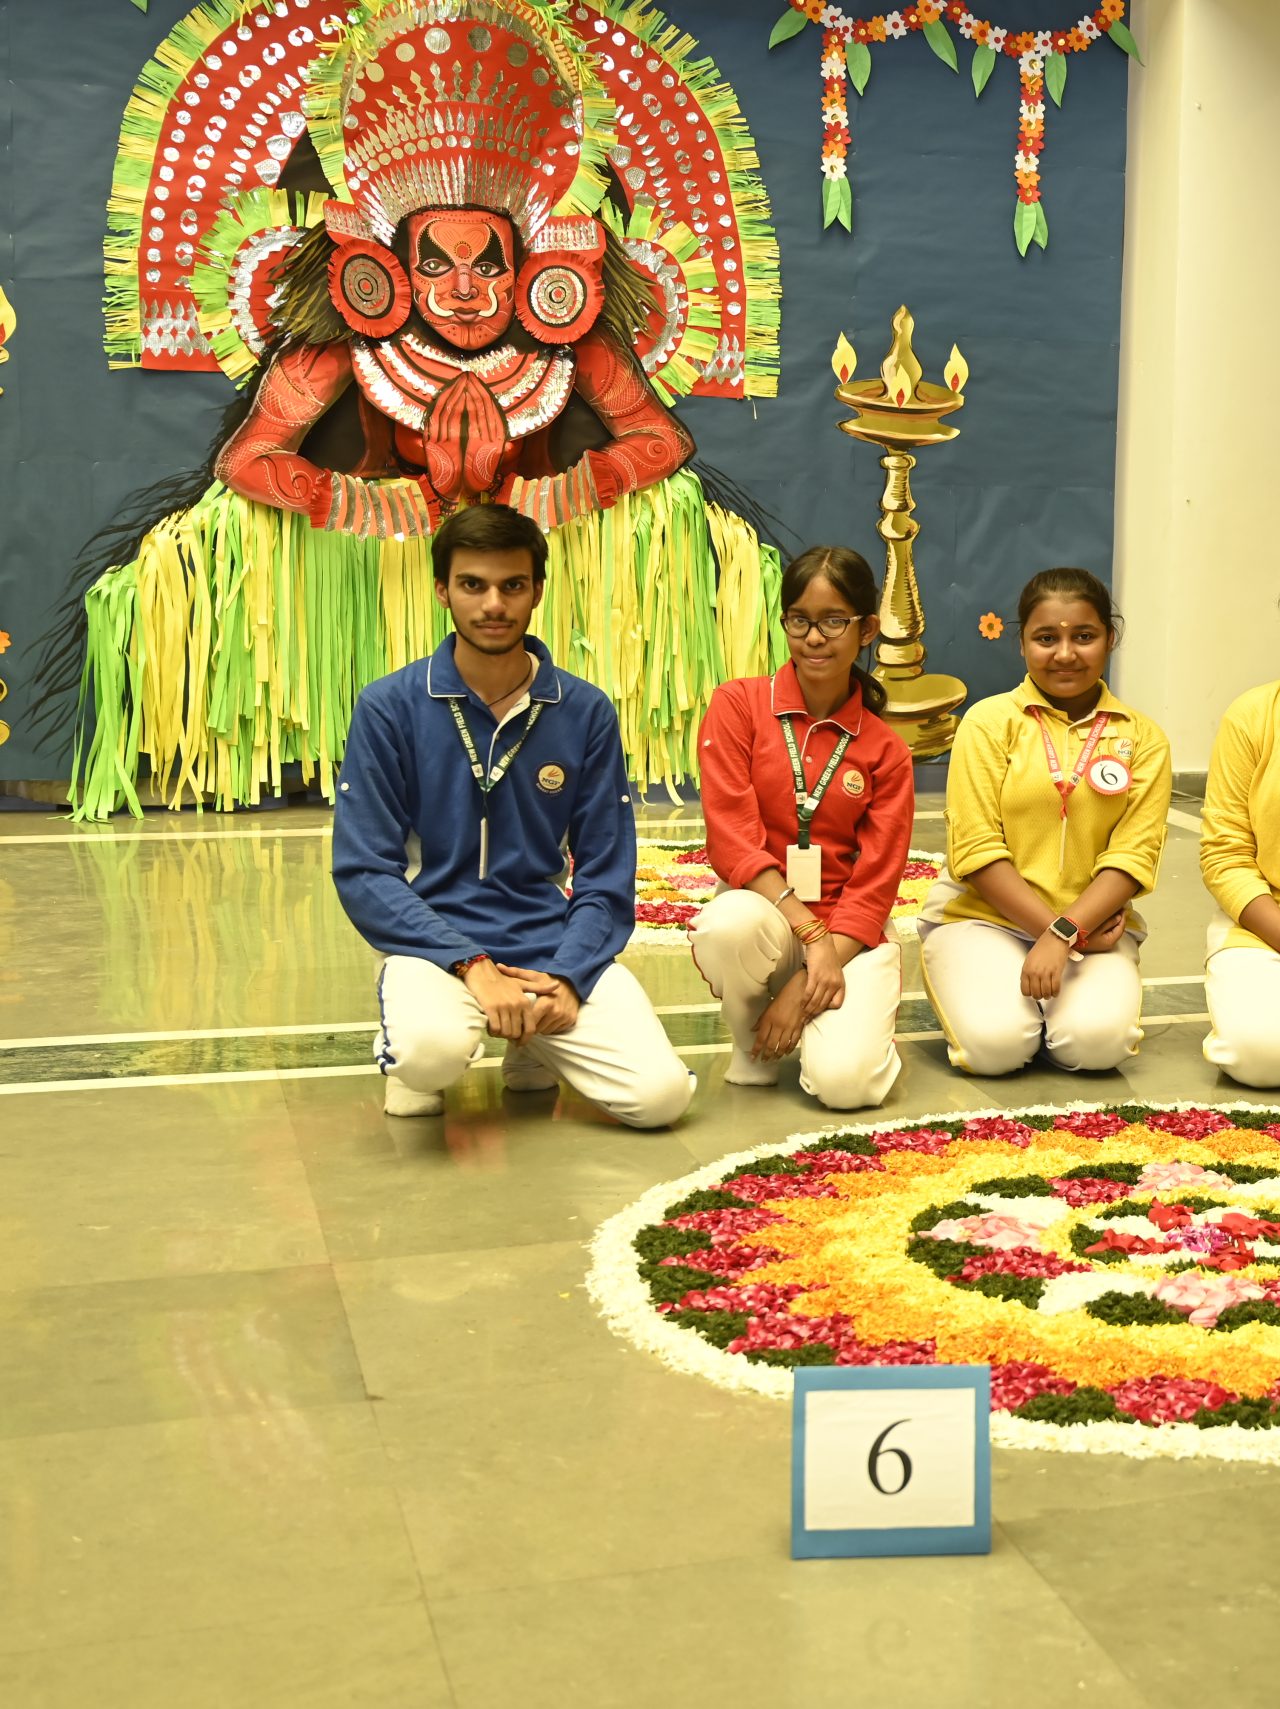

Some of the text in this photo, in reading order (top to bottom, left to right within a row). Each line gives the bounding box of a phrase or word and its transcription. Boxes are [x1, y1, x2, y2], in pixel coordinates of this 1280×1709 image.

[454, 712, 466, 728] FIELD
[460, 729, 473, 748] GREEN
[468, 749, 477, 762] NEW
[788, 743, 797, 757] FIELD
[499, 755, 510, 767] NEW
[792, 758, 802, 775] GREEN
[813, 785, 823, 797] NEW
[819, 768, 833, 785] GREEN
[828, 755, 839, 768] FIELD
[1101, 765, 1118, 785] 6
[868, 1418, 912, 1495] 6
